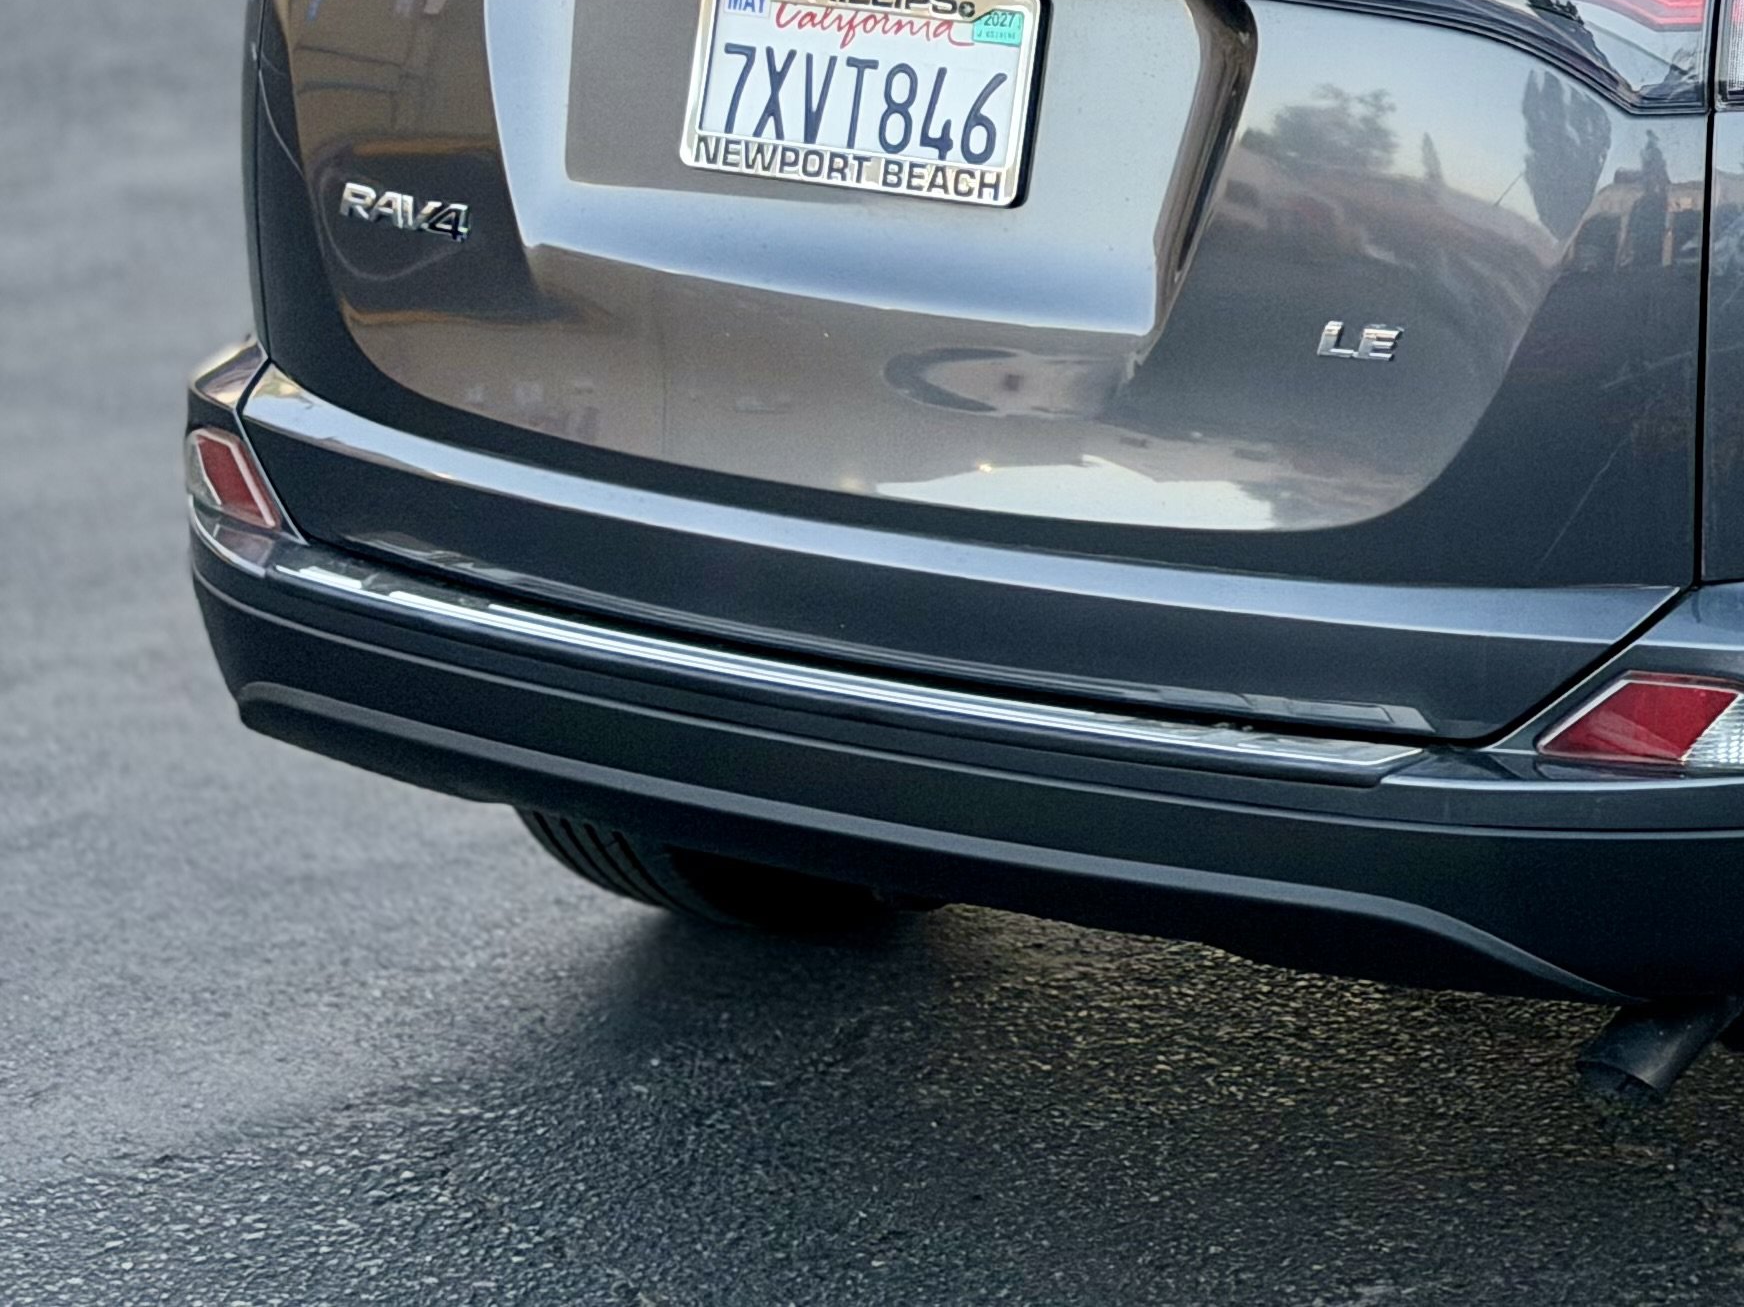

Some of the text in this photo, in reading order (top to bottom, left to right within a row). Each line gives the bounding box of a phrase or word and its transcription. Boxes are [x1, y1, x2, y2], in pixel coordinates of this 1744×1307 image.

[775, 2, 975, 49] California
[983, 11, 1016, 28] 2027
[724, 43, 1008, 165] 7XVT846
[695, 134, 1002, 201] NEWPORT BEACH
[339, 182, 471, 243] RAV4
[1316, 320, 1405, 362] LE
